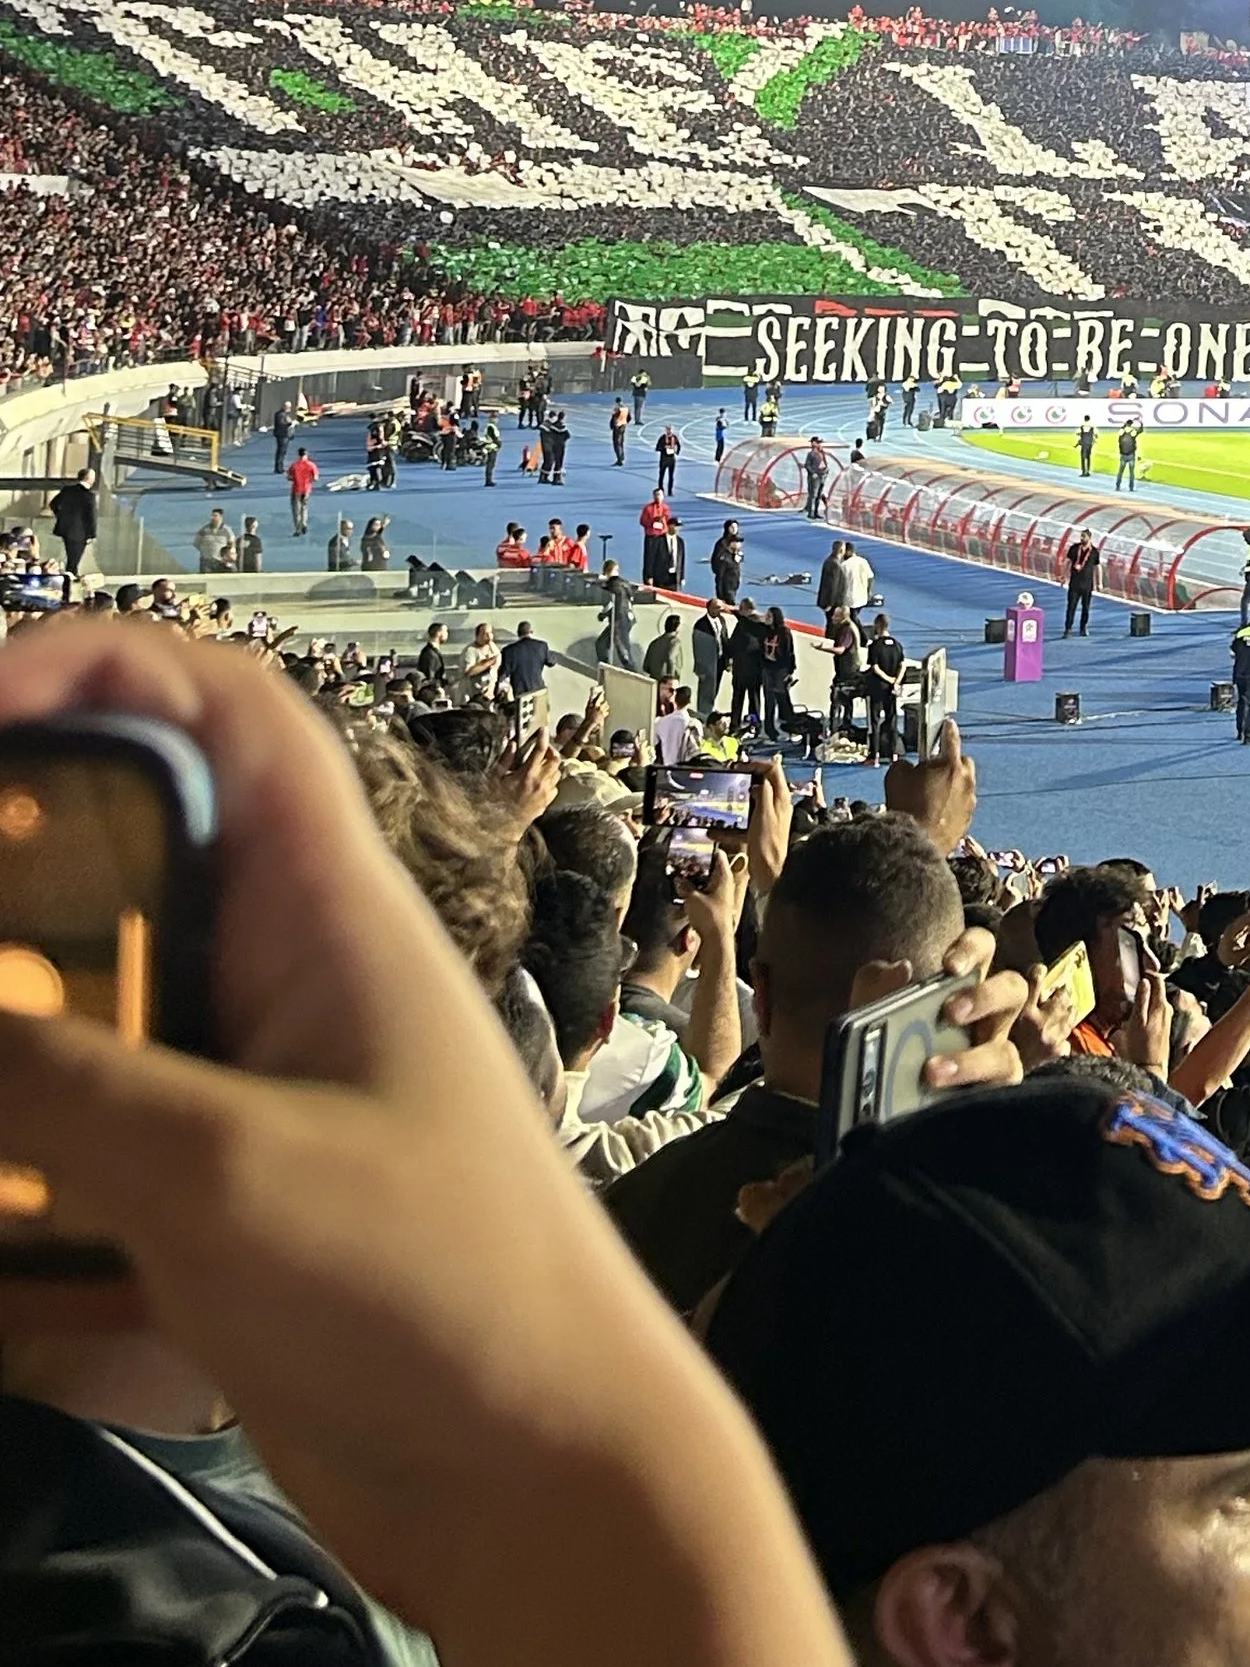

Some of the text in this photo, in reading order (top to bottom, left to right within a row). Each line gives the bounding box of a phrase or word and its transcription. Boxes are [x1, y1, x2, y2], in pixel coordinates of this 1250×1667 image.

[754, 314, 958, 383] SEEKING
[986, 318, 1048, 379] TO
[1077, 317, 1135, 382] BE
